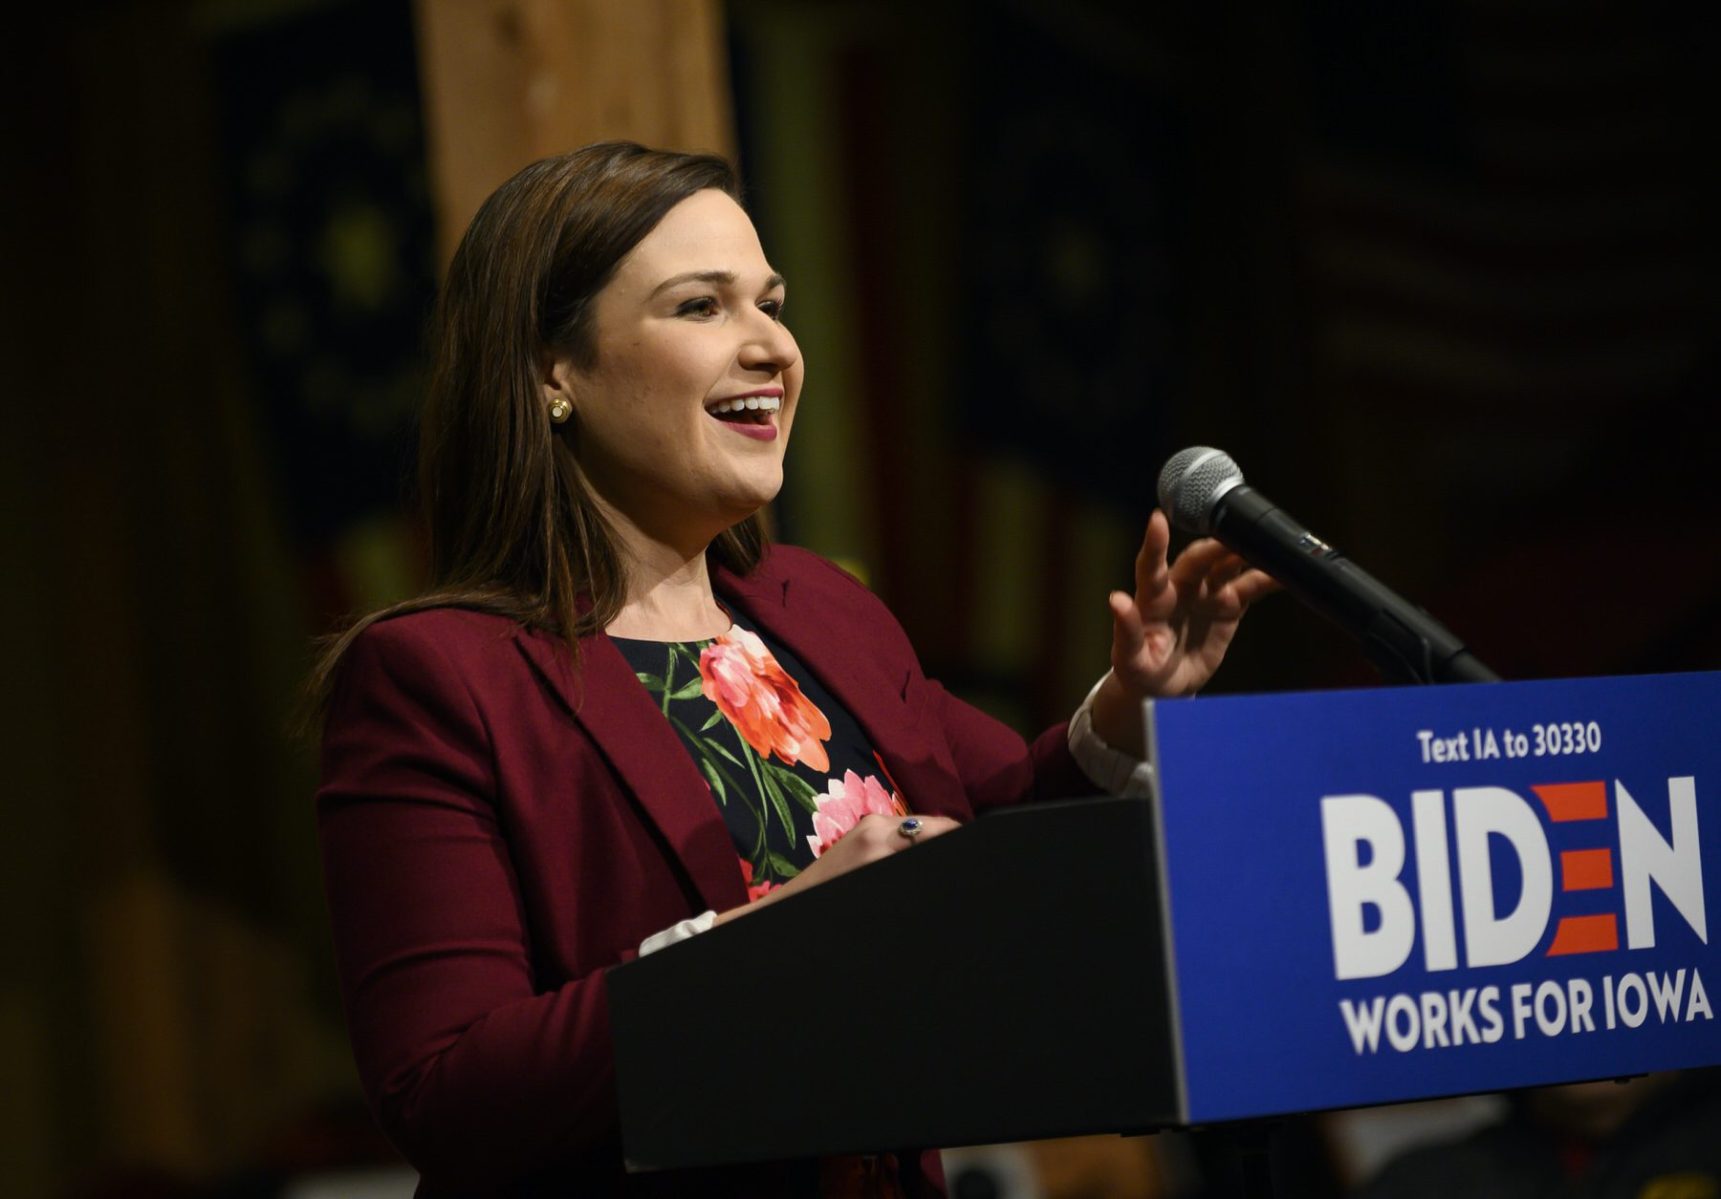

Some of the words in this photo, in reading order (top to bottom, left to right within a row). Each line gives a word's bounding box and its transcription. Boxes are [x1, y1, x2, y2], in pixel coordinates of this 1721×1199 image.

[1417, 730, 1470, 763] Text
[1473, 727, 1500, 760] IA
[1503, 729, 1529, 758] to
[1533, 721, 1601, 757] 30330
[1321, 776, 1708, 980] BIDEN
[1340, 986, 1504, 1055] WORKS
[1511, 978, 1596, 1040] FOR
[1603, 967, 1714, 1030] IOWA
